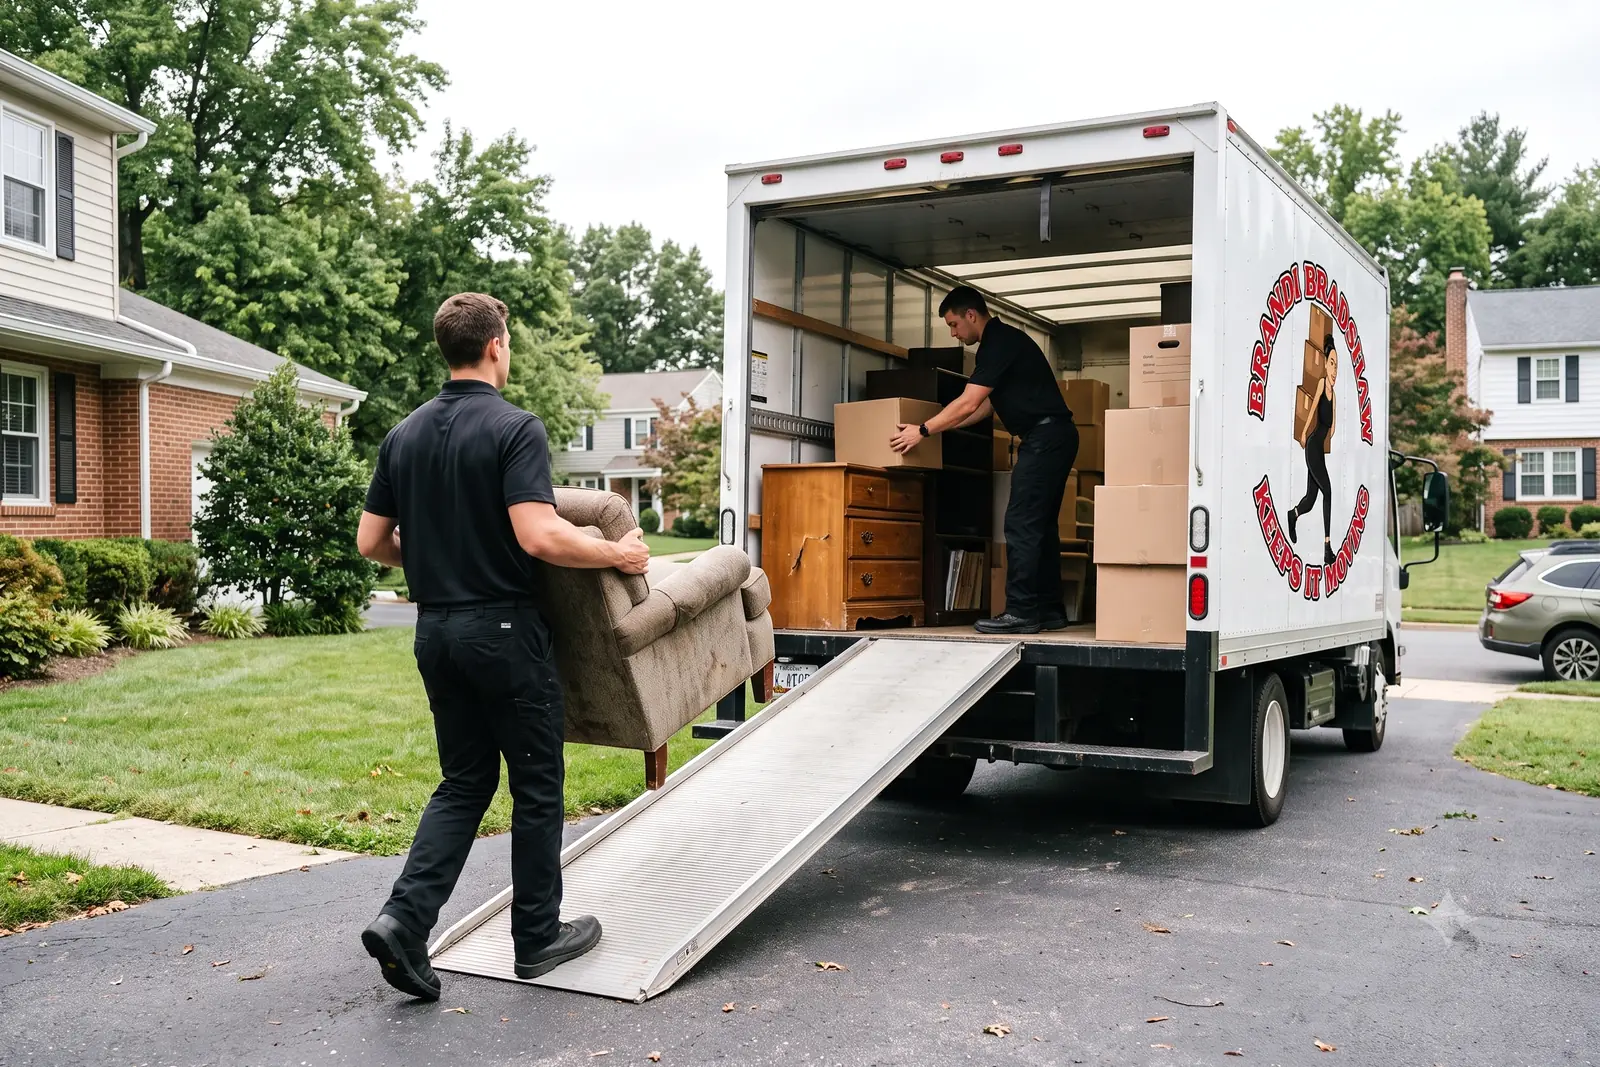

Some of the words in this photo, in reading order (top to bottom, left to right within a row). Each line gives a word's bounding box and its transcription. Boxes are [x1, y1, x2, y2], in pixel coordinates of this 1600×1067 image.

[1248, 262, 1302, 421] BRANDI
[1303, 260, 1373, 446] BRADSHAW
[1252, 474, 1303, 592] KEEPS
[1304, 564, 1322, 601] IT
[1324, 484, 1369, 598] MOVING
